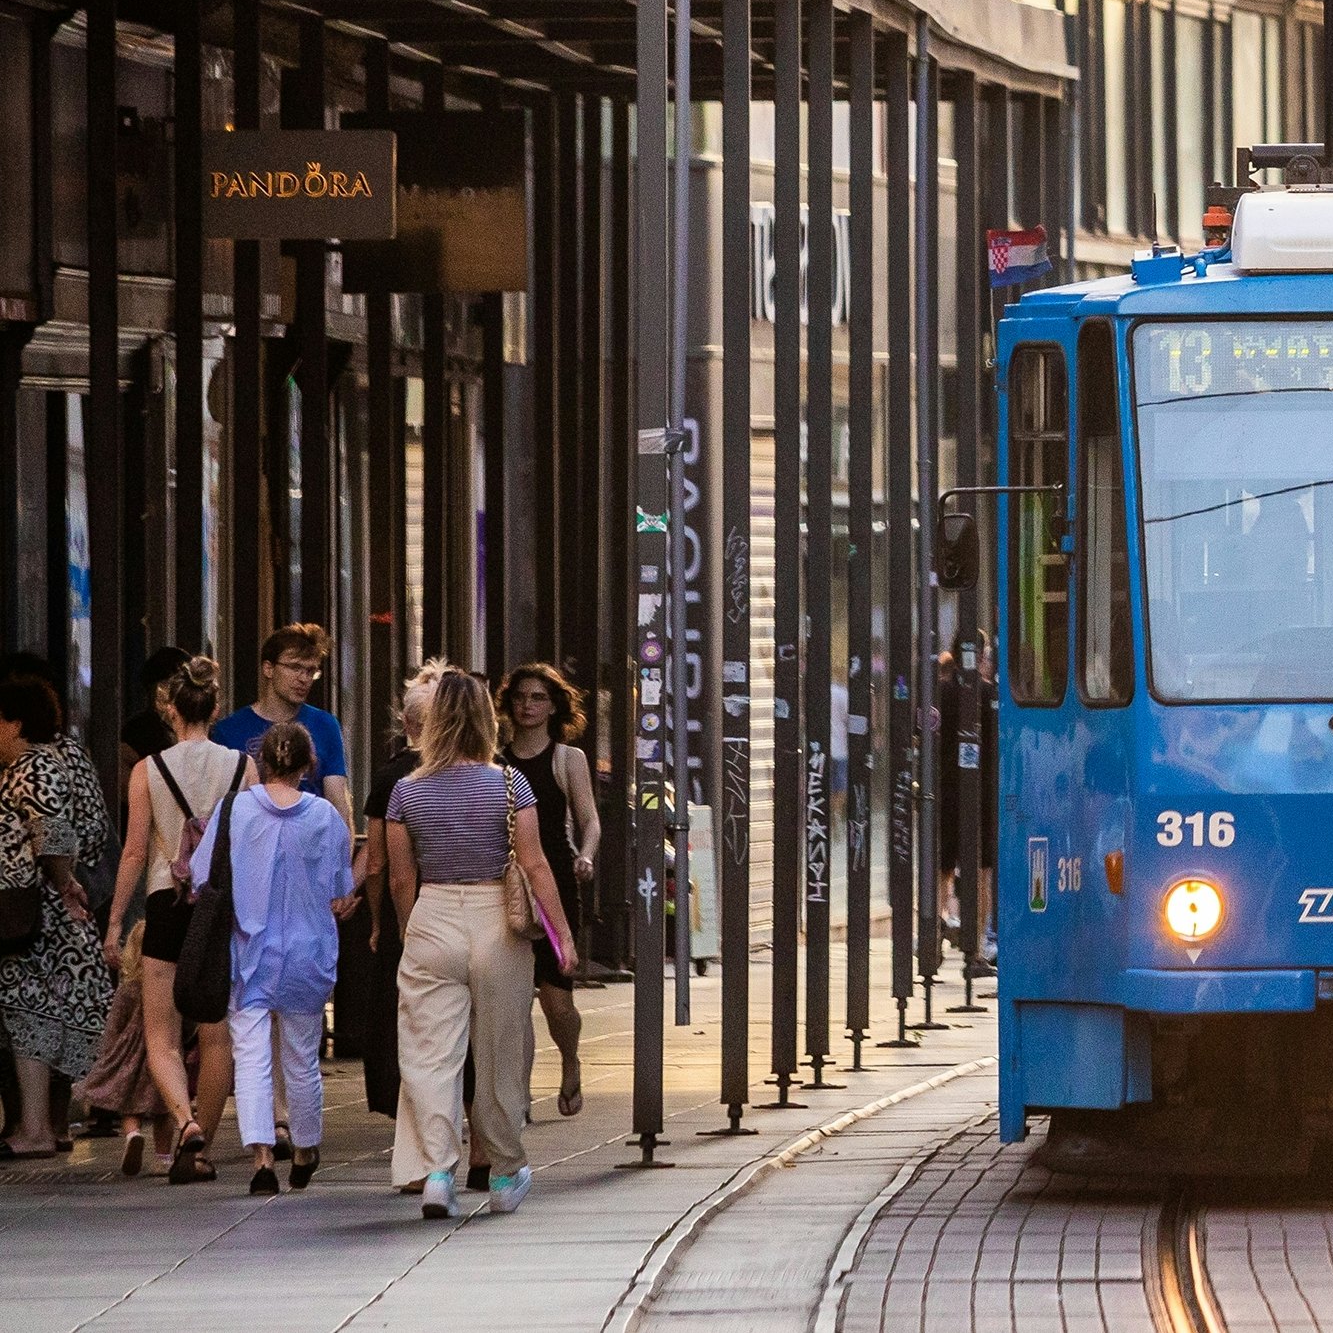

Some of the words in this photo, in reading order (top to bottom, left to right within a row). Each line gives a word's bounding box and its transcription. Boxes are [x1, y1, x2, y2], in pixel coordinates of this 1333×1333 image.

[210, 162, 373, 198] PANDORA
[1159, 330, 1212, 392] 13
[1157, 810, 1236, 848] 316
